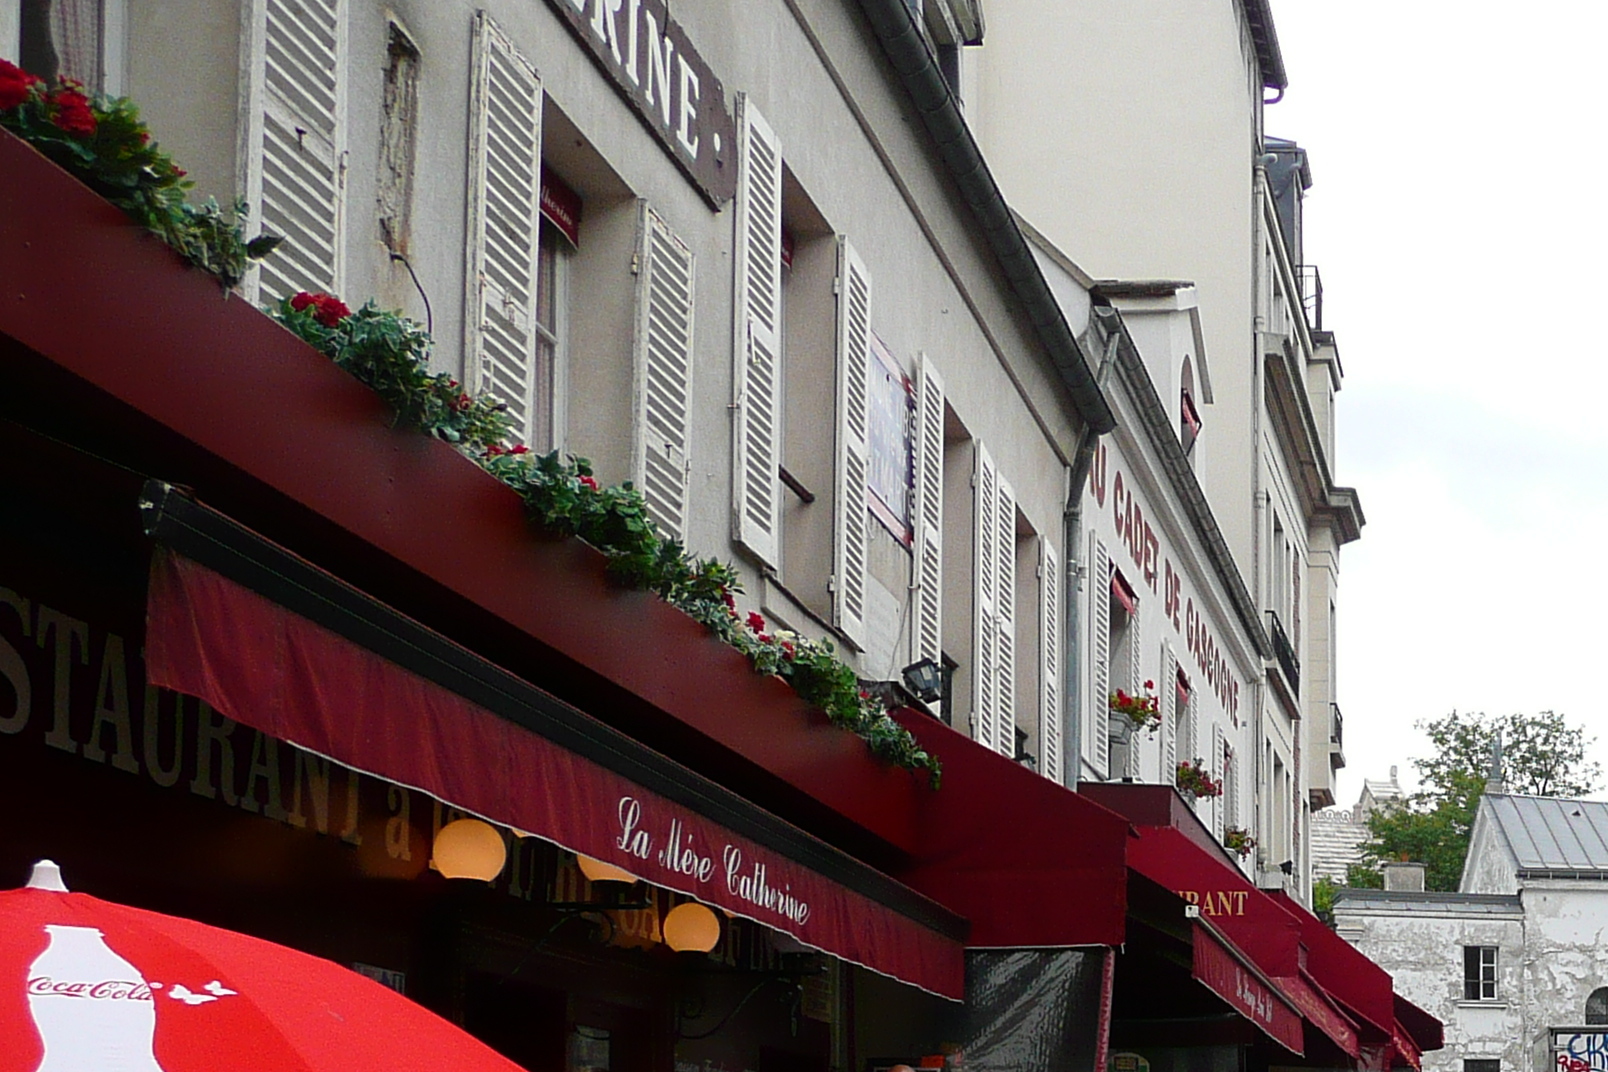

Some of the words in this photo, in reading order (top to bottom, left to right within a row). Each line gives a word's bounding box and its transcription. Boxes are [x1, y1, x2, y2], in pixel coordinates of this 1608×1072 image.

[565, 0, 699, 160] RINE
[1113, 470, 1159, 597] CADET
[1164, 557, 1181, 635] DE
[1186, 597, 1239, 731] GASCOGNE
[616, 796, 655, 860] La
[723, 844, 811, 926] Catherine
[1178, 890, 1249, 917] RANT
[28, 976, 153, 1001] Coca-Cola
